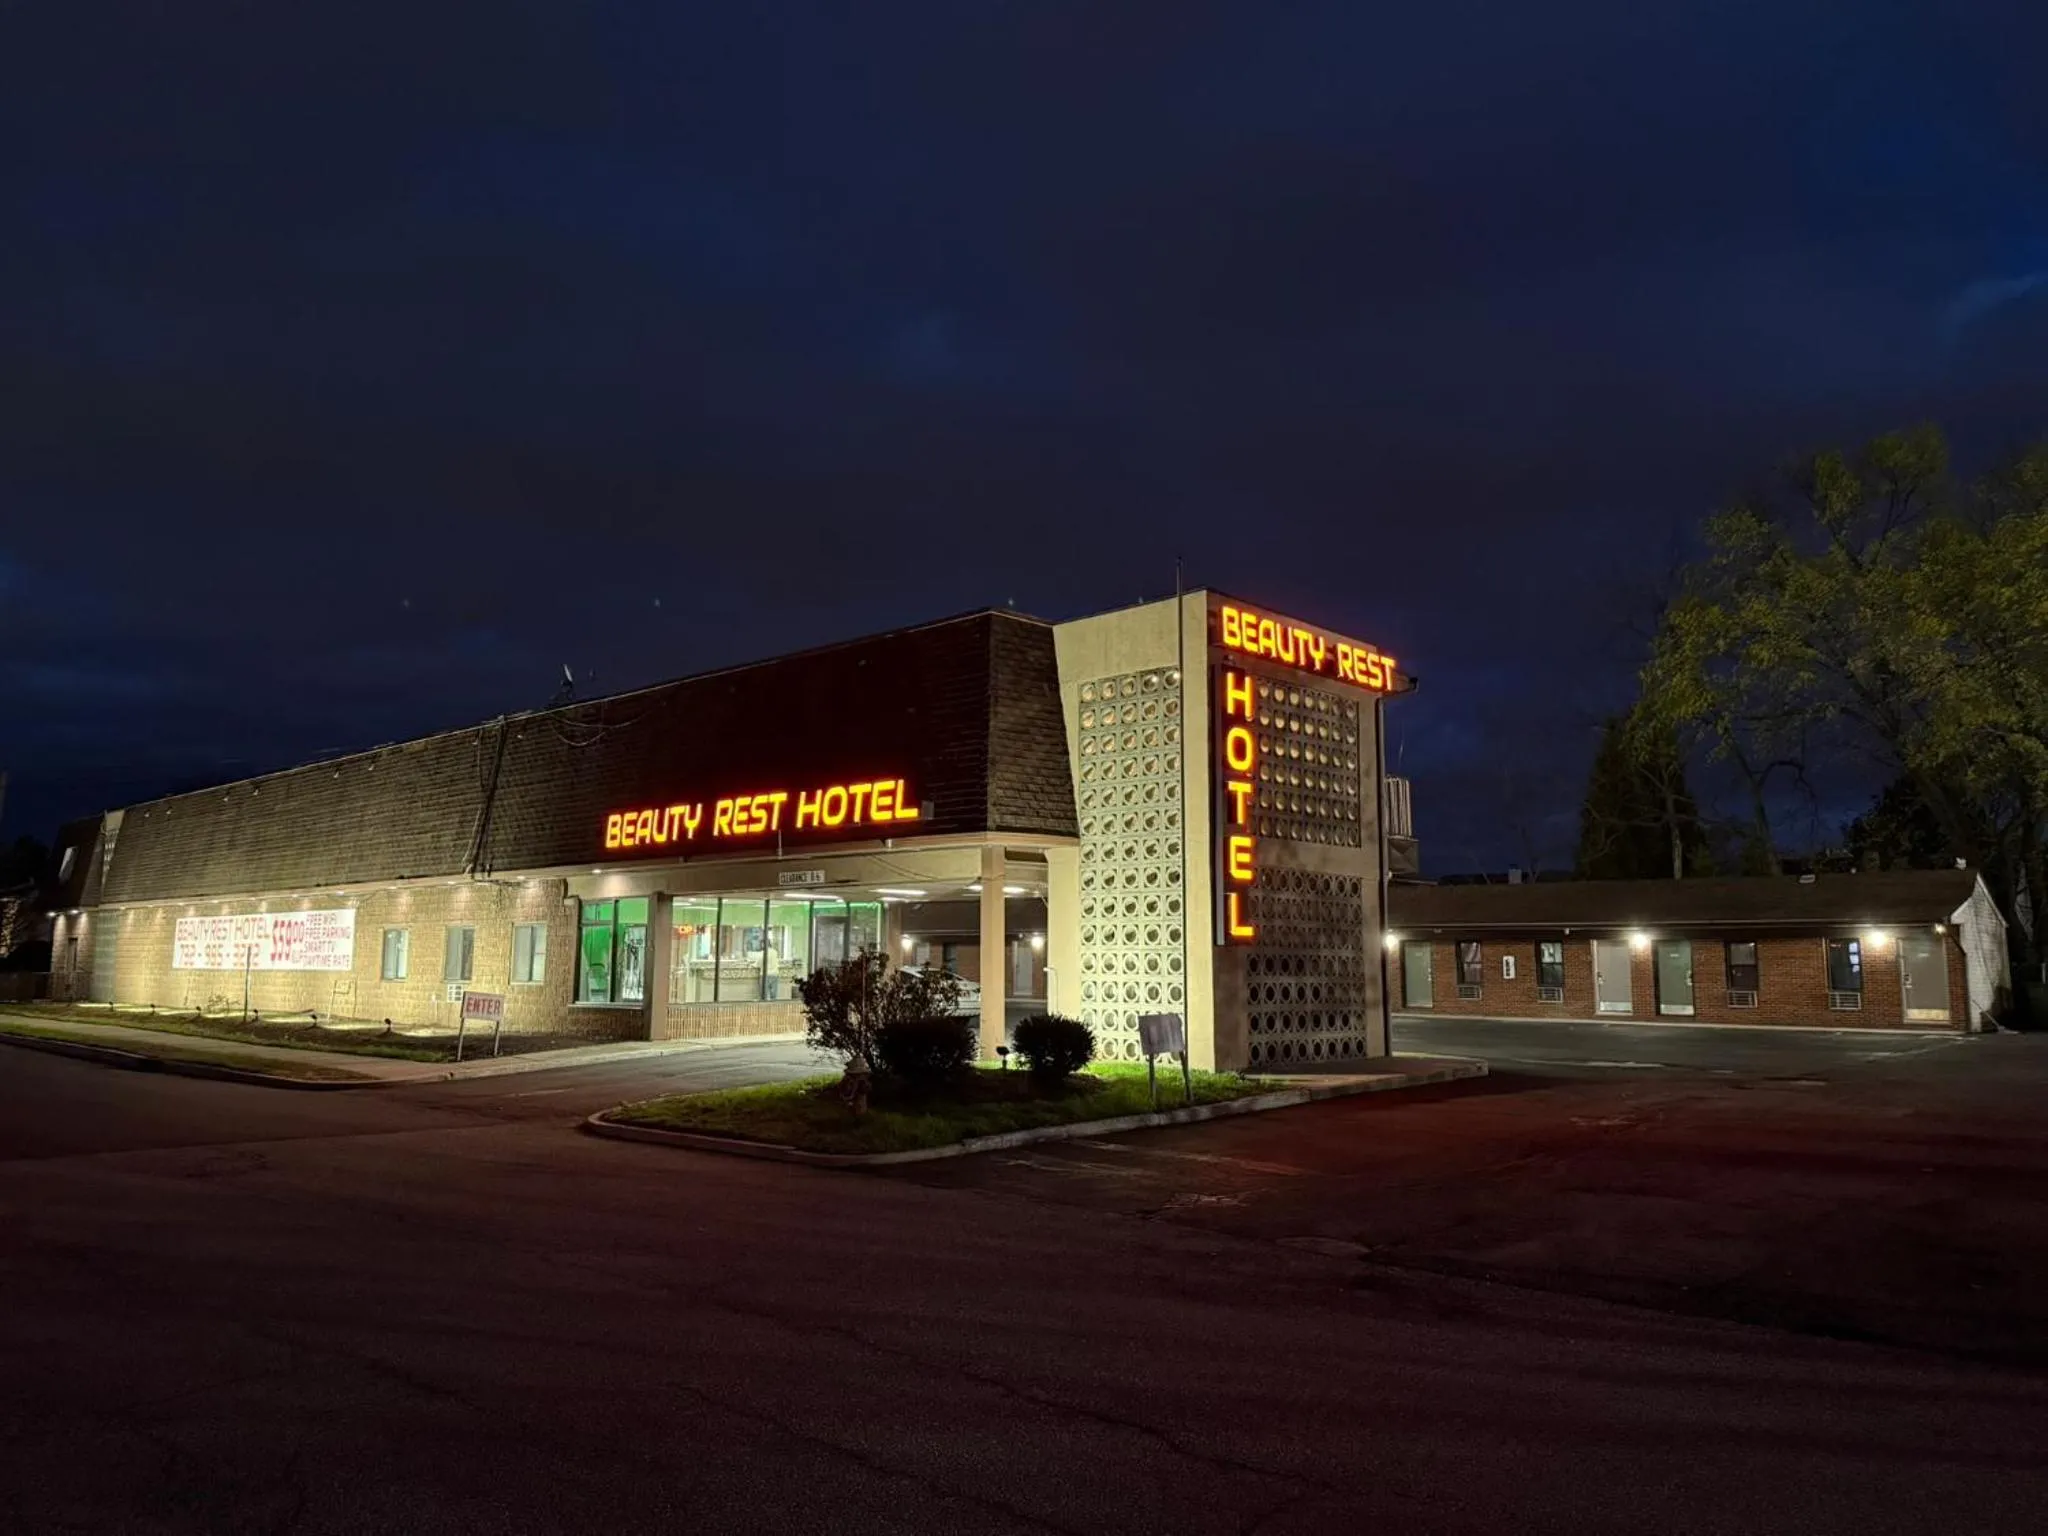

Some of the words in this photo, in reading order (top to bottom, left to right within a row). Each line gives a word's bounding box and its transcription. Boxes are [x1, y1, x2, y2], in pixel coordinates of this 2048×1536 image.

[1222, 606, 1325, 670] BEAUTY
[1336, 643, 1396, 691] REST
[605, 803, 703, 848] BEAUTY
[713, 792, 787, 837] REST
[796, 779, 918, 829] HOTEL
[1226, 672, 1255, 936] HOTEL
[235, 916, 270, 939] HOTEL
[323, 926, 351, 940] PARKING
[466, 996, 501, 1016] ENTER
